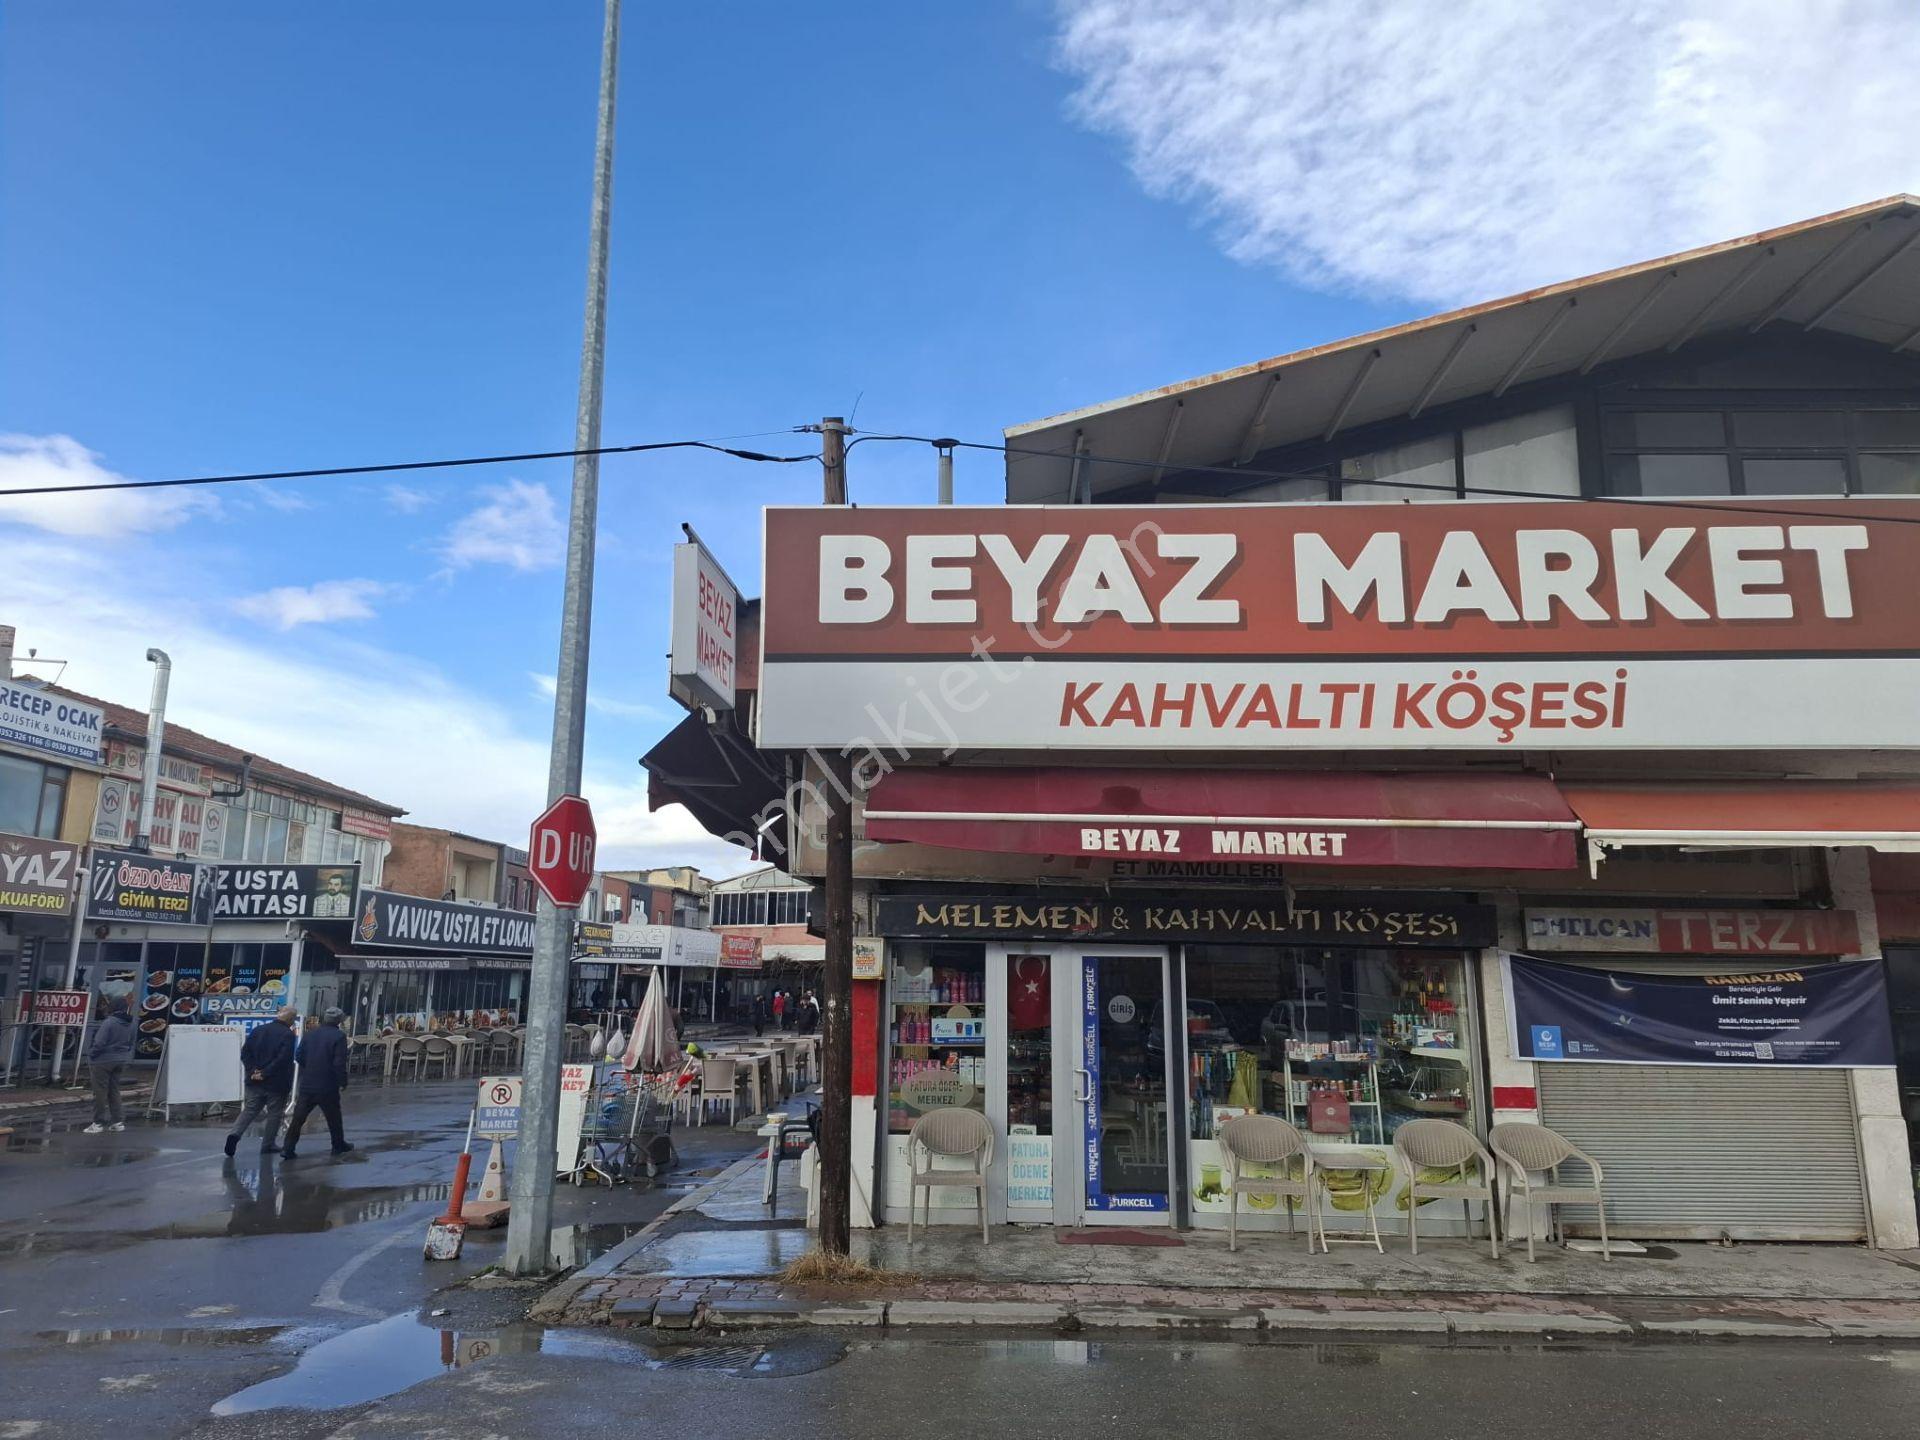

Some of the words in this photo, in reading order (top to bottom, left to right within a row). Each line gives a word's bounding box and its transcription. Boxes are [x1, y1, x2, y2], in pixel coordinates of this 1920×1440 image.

[819, 533, 1239, 623] BEYAZ
[1293, 525, 1869, 623] MARKET
[699, 570, 732, 639] BEYAZ
[697, 623, 733, 689] MARKET
[0, 686, 52, 716] RECEP
[57, 704, 100, 731] OCAK
[1059, 682, 1376, 729] KAHVALTI
[1393, 668, 1628, 743] KÖŞESİ
[0, 710, 41, 730] OJİSTİK
[44, 721, 50, 732] &
[53, 725, 97, 744] NAKLİYAT
[538, 828, 593, 874] DUR
[1081, 829, 1180, 853] BEYAZ
[1212, 831, 1347, 856] MARKET
[1, 851, 71, 888] YAZ
[118, 860, 192, 893] ÖZDOĞAN
[234, 870, 299, 890] USTA
[0, 890, 65, 910] KUAFÖRÜ
[119, 889, 156, 909] GİYİM
[158, 895, 188, 912] TERZİ
[387, 903, 441, 942] YAVUZ
[443, 912, 480, 945] USTA
[481, 917, 500, 945] ET
[916, 904, 1098, 929] MELEMEN
[1111, 906, 1130, 930] &
[1144, 907, 1321, 931] KAHVALTI
[1335, 907, 1459, 941] KÖŞESİ
[207, 998, 273, 1011] BANYO
[1110, 1002, 1134, 1015] GİRİŞ
[1712, 994, 1737, 1005] Ümit
[1738, 996, 1774, 1005] Seninle
[1774, 996, 1808, 1007] Yeşerir
[480, 1119, 519, 1129] MARKET
[485, 1108, 516, 1117] BEYAZ
[1012, 1143, 1049, 1158] FATURA
[1013, 1161, 1048, 1179] ÖDEME
[1112, 1198, 1154, 1207] TURKCELL
